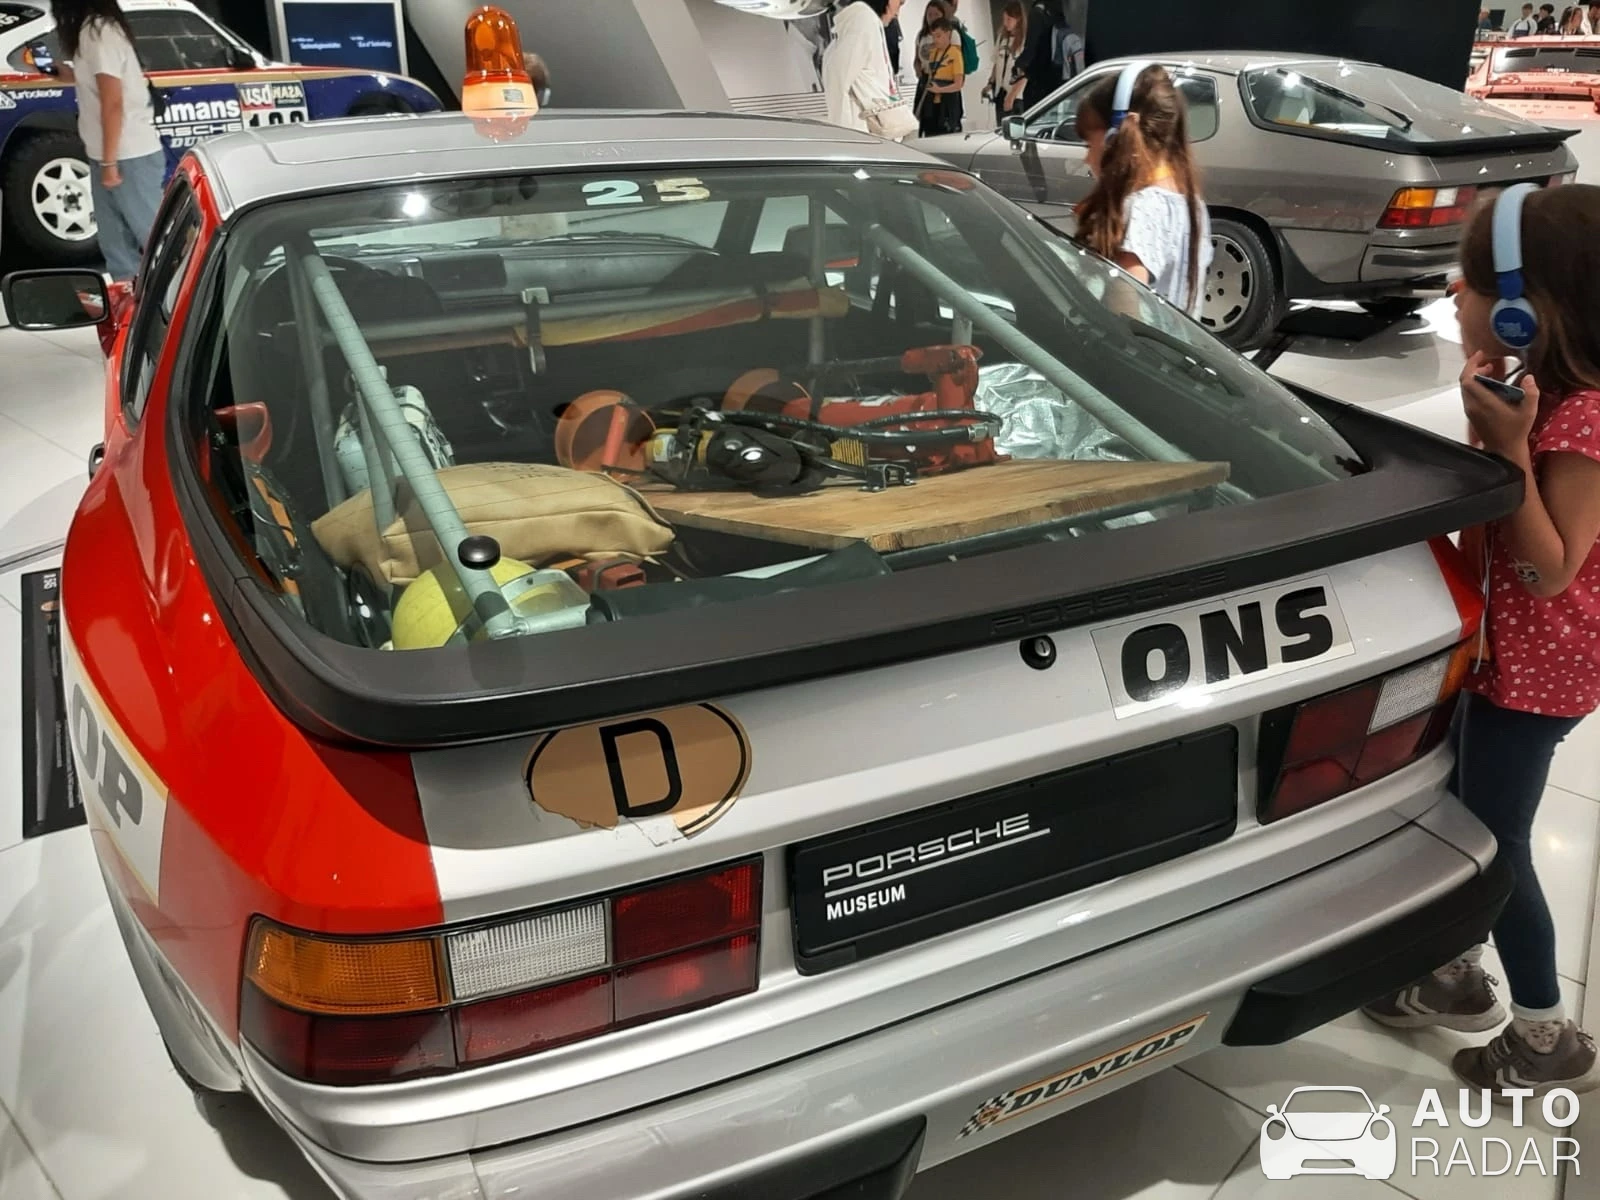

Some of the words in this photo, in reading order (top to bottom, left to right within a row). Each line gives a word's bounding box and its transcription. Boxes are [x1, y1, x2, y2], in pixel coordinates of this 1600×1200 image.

[155, 99, 241, 124] mans
[1121, 585, 1334, 703] ONS
[72, 682, 144, 830] OP
[599, 717, 683, 818] D
[822, 813, 1031, 887] PORSCHE
[825, 883, 906, 921] MUSEUM
[1003, 1024, 1196, 1115] DUNLOP
